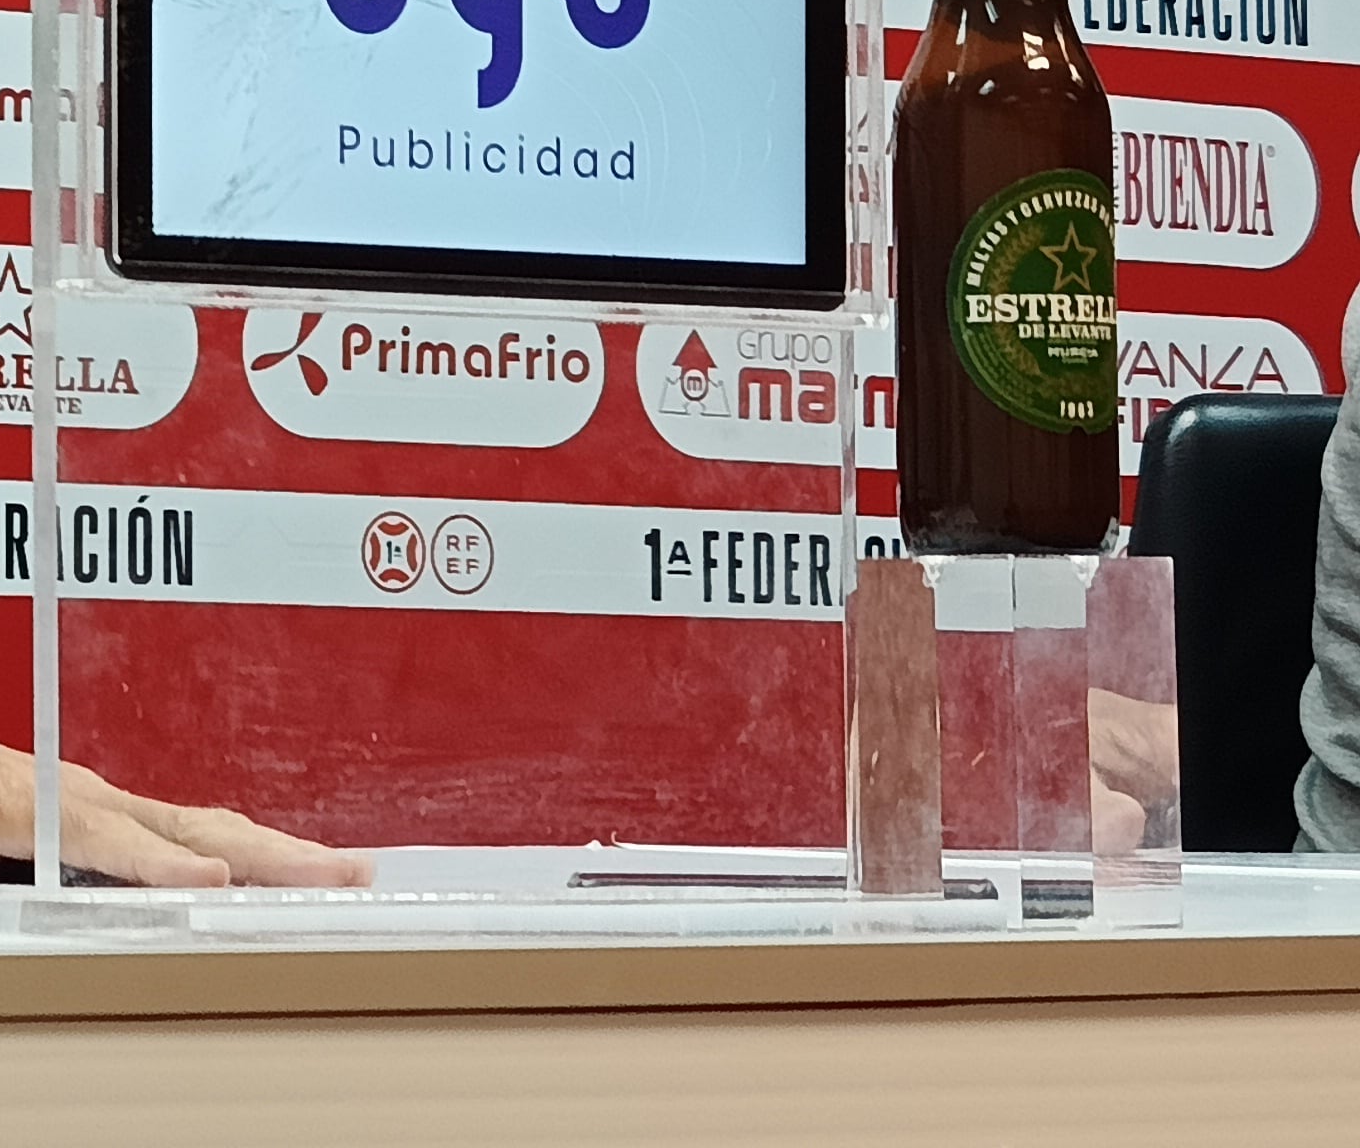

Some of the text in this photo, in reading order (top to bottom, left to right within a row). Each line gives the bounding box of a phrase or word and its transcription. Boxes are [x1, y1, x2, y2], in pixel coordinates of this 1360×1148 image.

[338, 125, 638, 181] Publicidad
[341, 323, 591, 385] PrimaFrio
[737, 330, 833, 369] Grupo
